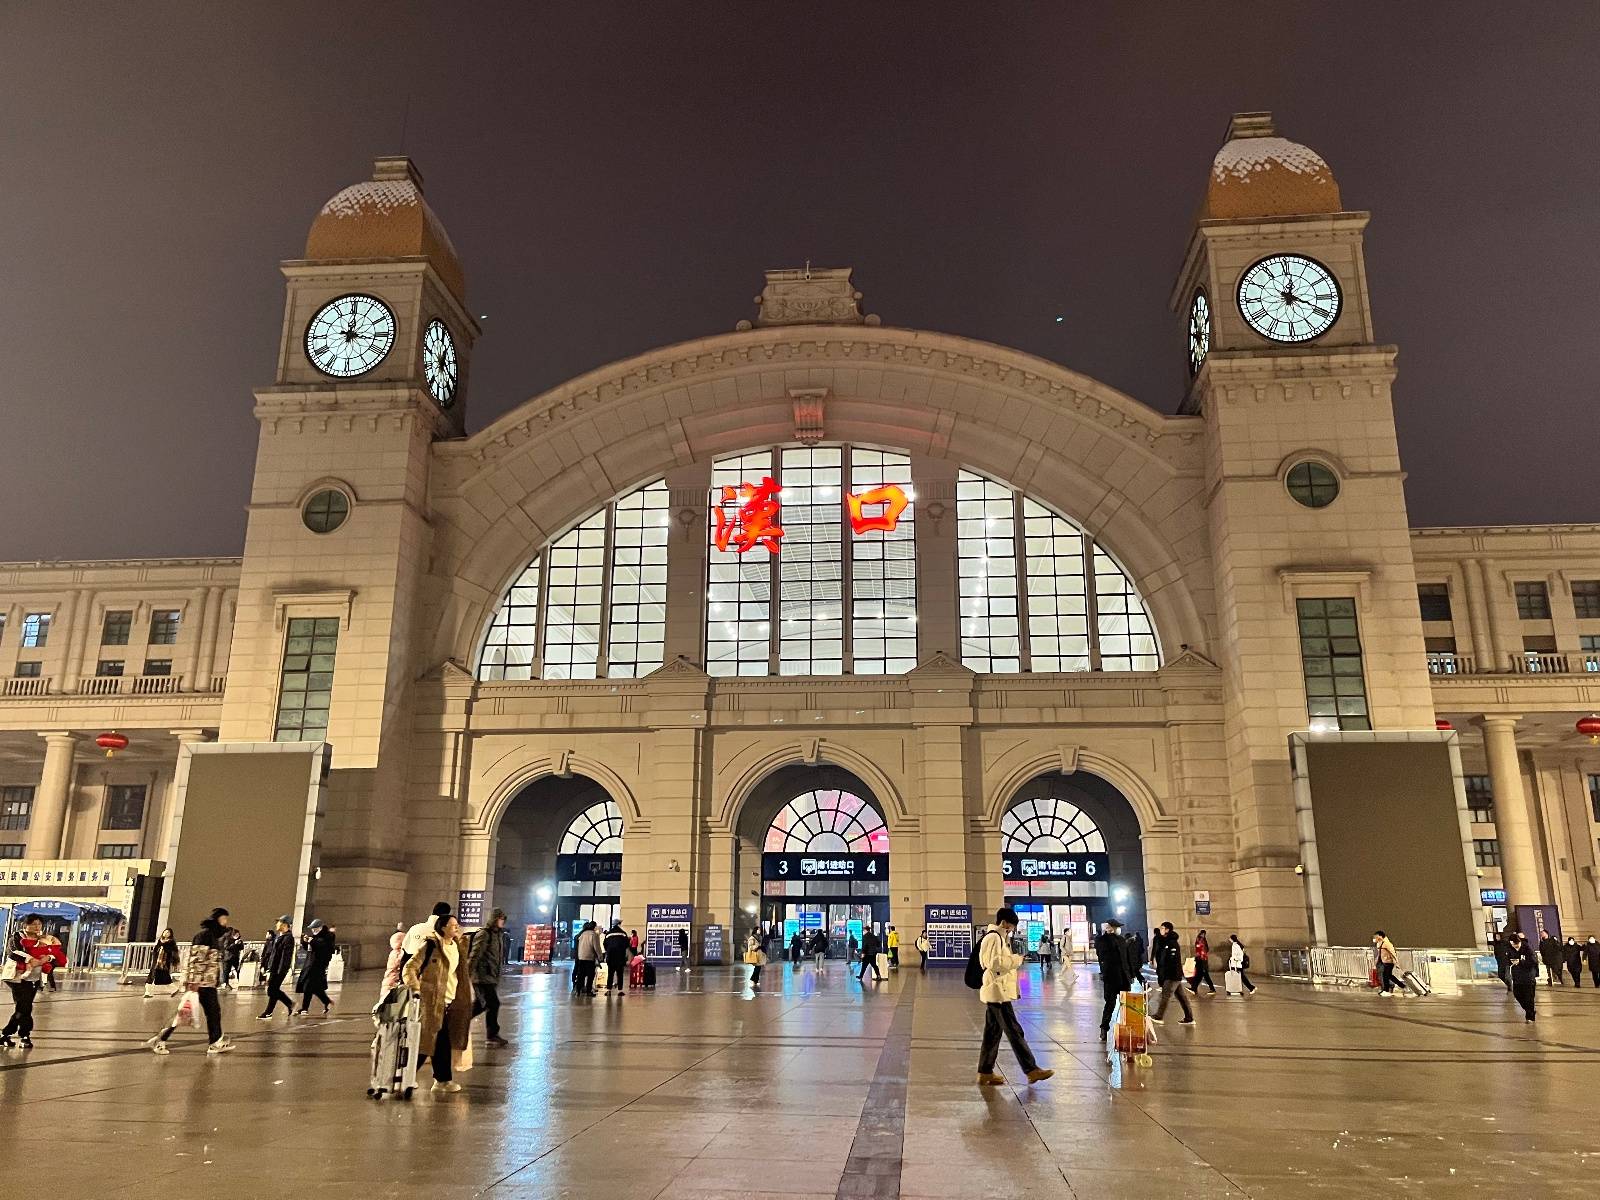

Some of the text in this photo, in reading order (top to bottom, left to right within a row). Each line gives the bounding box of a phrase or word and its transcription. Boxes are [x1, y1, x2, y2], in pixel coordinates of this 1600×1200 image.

[778, 860, 789, 875] 3
[817, 860, 855, 869] 南1进站口
[866, 860, 877, 875] 4
[1002, 860, 1013, 875] 5
[1037, 860, 1077, 870] 南1进站口
[1085, 860, 1097, 875] 6
